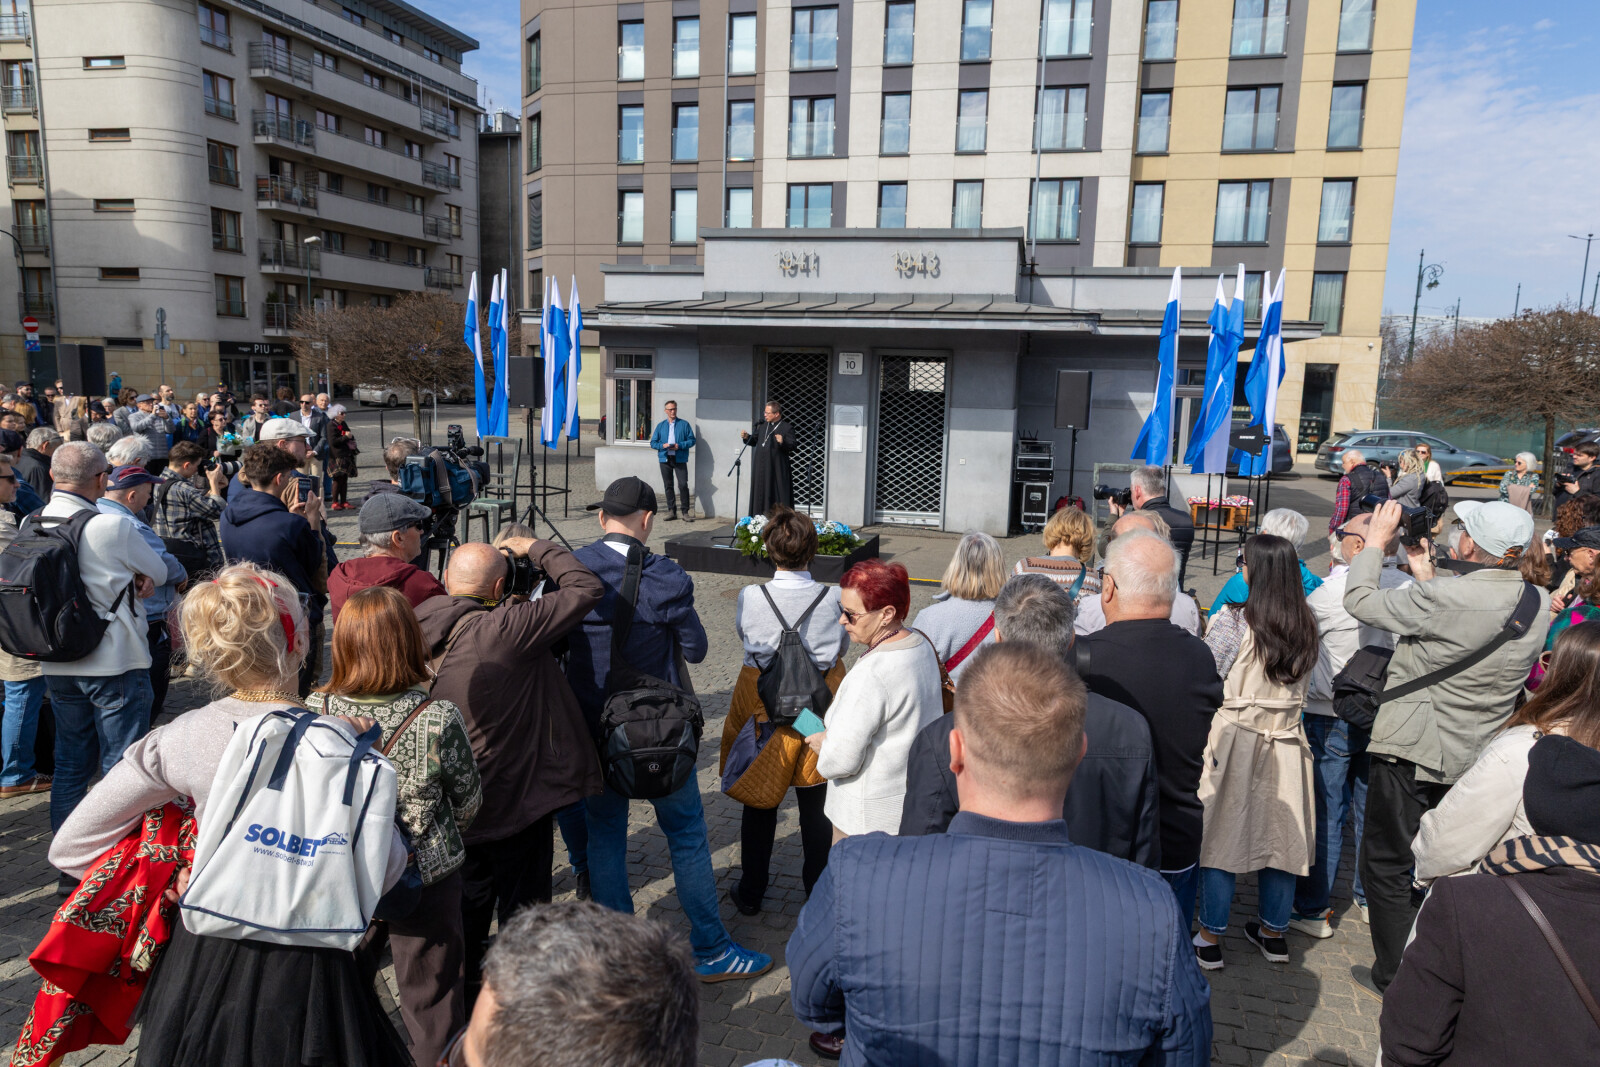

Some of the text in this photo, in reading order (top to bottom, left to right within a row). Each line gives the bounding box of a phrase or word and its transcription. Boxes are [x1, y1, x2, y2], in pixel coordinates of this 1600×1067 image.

[774, 248, 937, 271] 1941 1943
[254, 344, 270, 354] PIU
[845, 360, 856, 370] 10
[244, 823, 322, 857] SOLBET
[253, 846, 315, 867] www.sobet-stwpl
